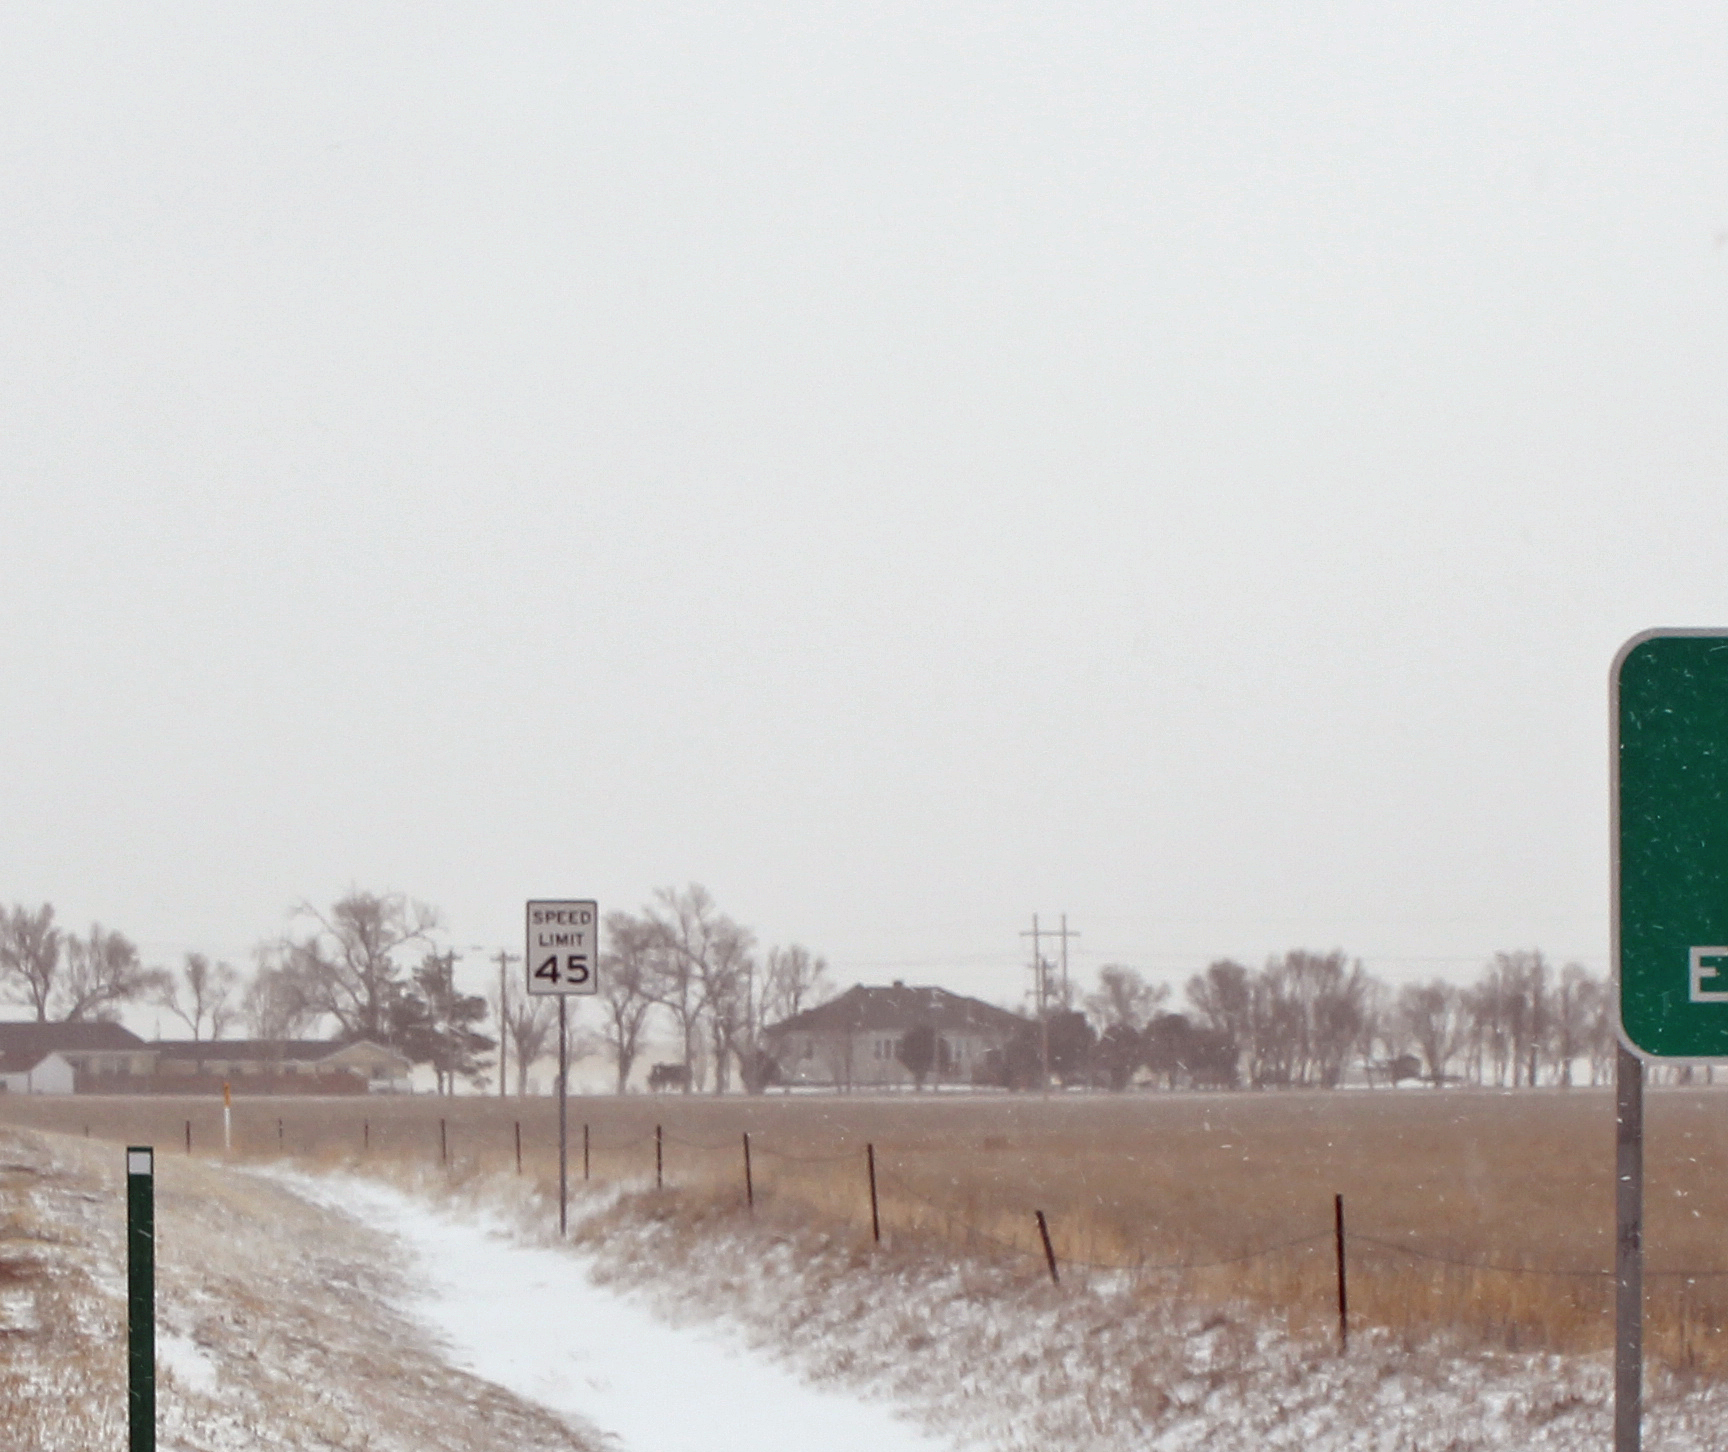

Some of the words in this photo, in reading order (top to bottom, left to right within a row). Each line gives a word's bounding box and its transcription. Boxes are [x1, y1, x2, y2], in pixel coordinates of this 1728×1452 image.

[533, 910, 591, 925] SPEED
[539, 932, 584, 947] LIMIT
[534, 954, 590, 984] 45
